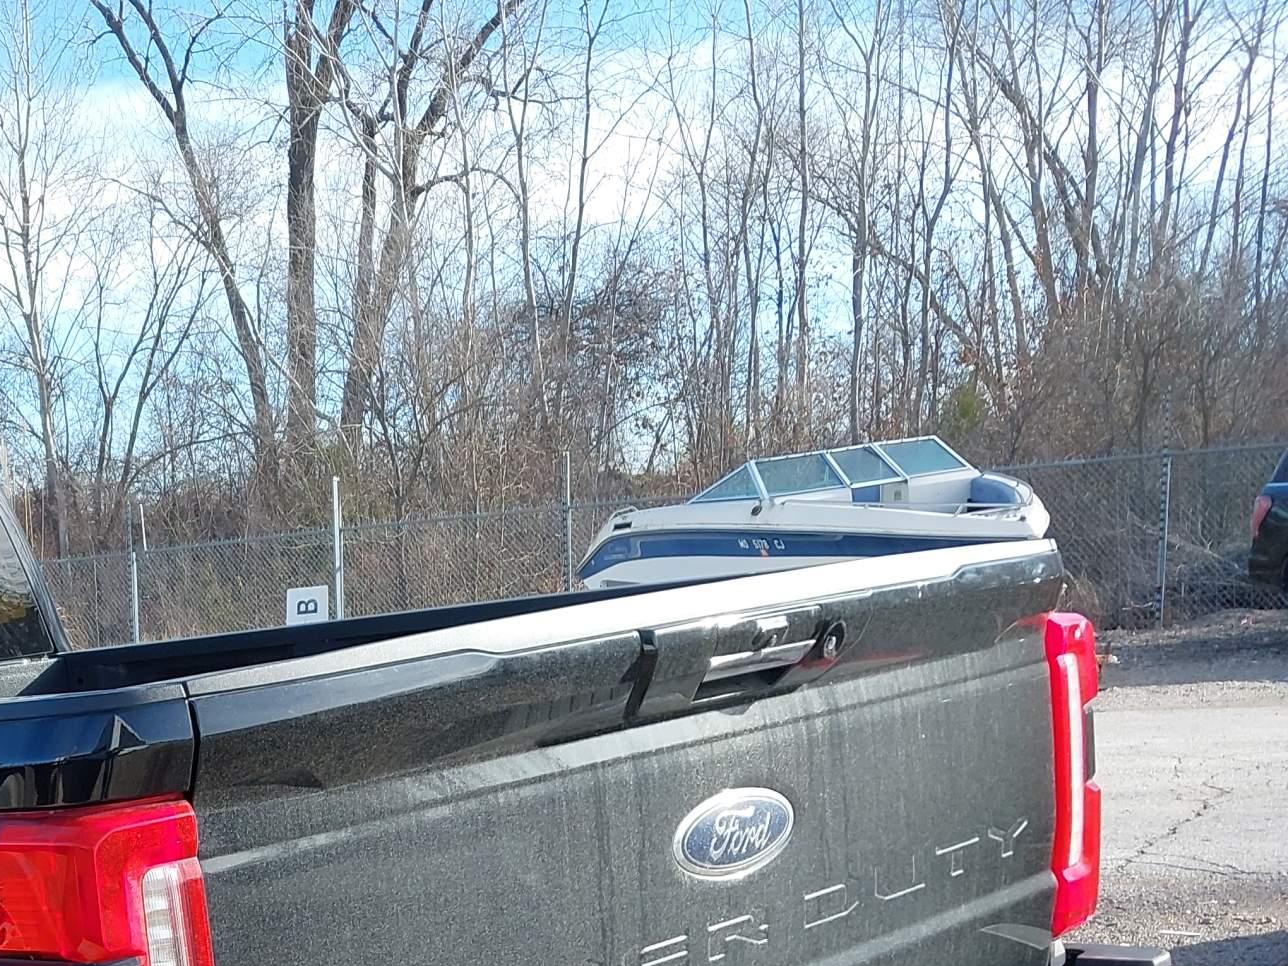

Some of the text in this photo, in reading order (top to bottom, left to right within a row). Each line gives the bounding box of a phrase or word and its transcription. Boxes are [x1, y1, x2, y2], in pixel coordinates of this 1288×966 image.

[773, 538, 785, 549] CJ
[296, 598, 318, 615] B
[709, 805, 772, 862] Ford
[803, 818, 1029, 929] DUTY
